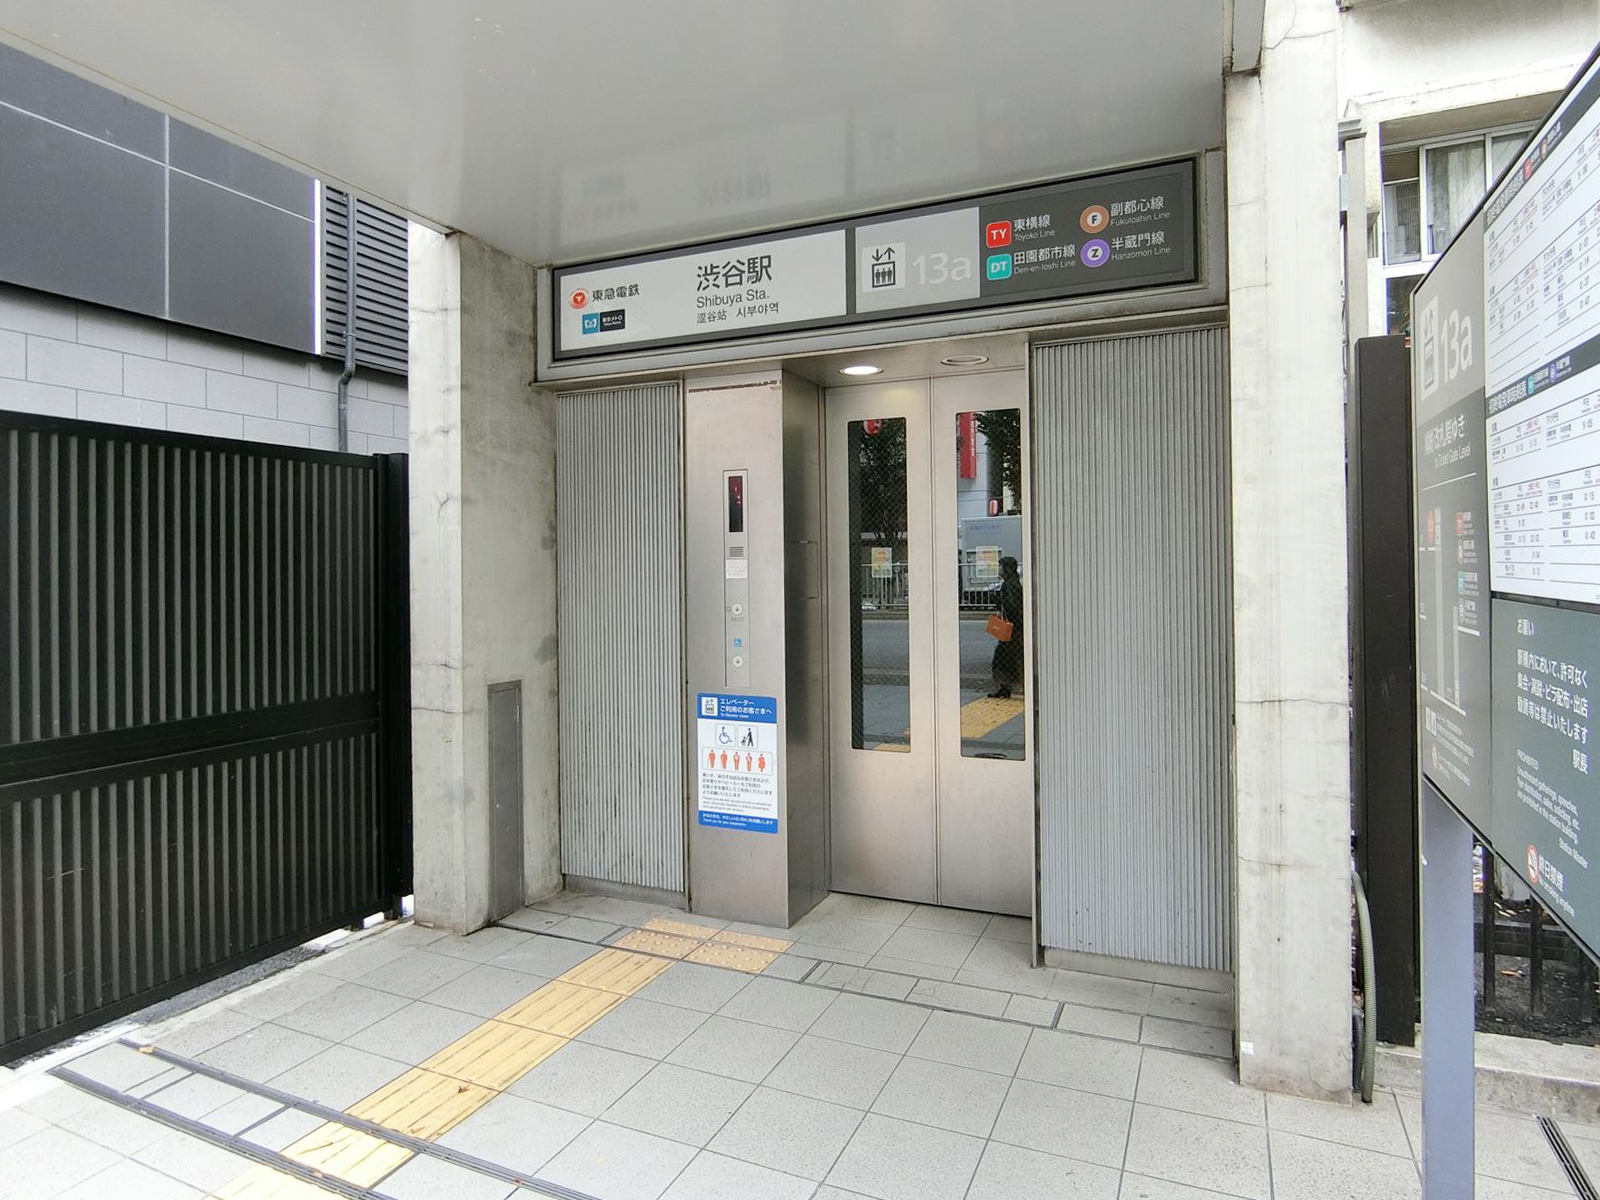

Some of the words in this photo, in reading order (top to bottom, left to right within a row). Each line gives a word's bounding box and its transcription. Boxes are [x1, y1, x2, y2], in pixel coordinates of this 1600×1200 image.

[1110, 196, 1164, 217] 副都心線
[1013, 214, 1051, 232] 東横線
[1111, 214, 1152, 226] Fukutoshin
[1153, 212, 1171, 221] Line
[991, 228, 1007, 241] TY
[1014, 231, 1039, 242] Toyoko
[1040, 229, 1055, 239] Line
[1111, 231, 1165, 250] 半蔵門線
[1014, 244, 1076, 265] 田園都市線
[1111, 249, 1152, 261] Hanzomon
[1153, 246, 1171, 256] Line
[912, 251, 971, 286] 13a
[991, 261, 1007, 274] DT
[1060, 258, 1076, 268] Line
[697, 254, 772, 292] 渋谷駅
[592, 284, 640, 302] 東急電鉄
[696, 293, 742, 309] Shibuya
[746, 288, 770, 302] Sta.
[736, 302, 779, 318] 시부야역
[1440, 308, 1472, 384] 13a
[720, 698, 755, 706] エレベーター
